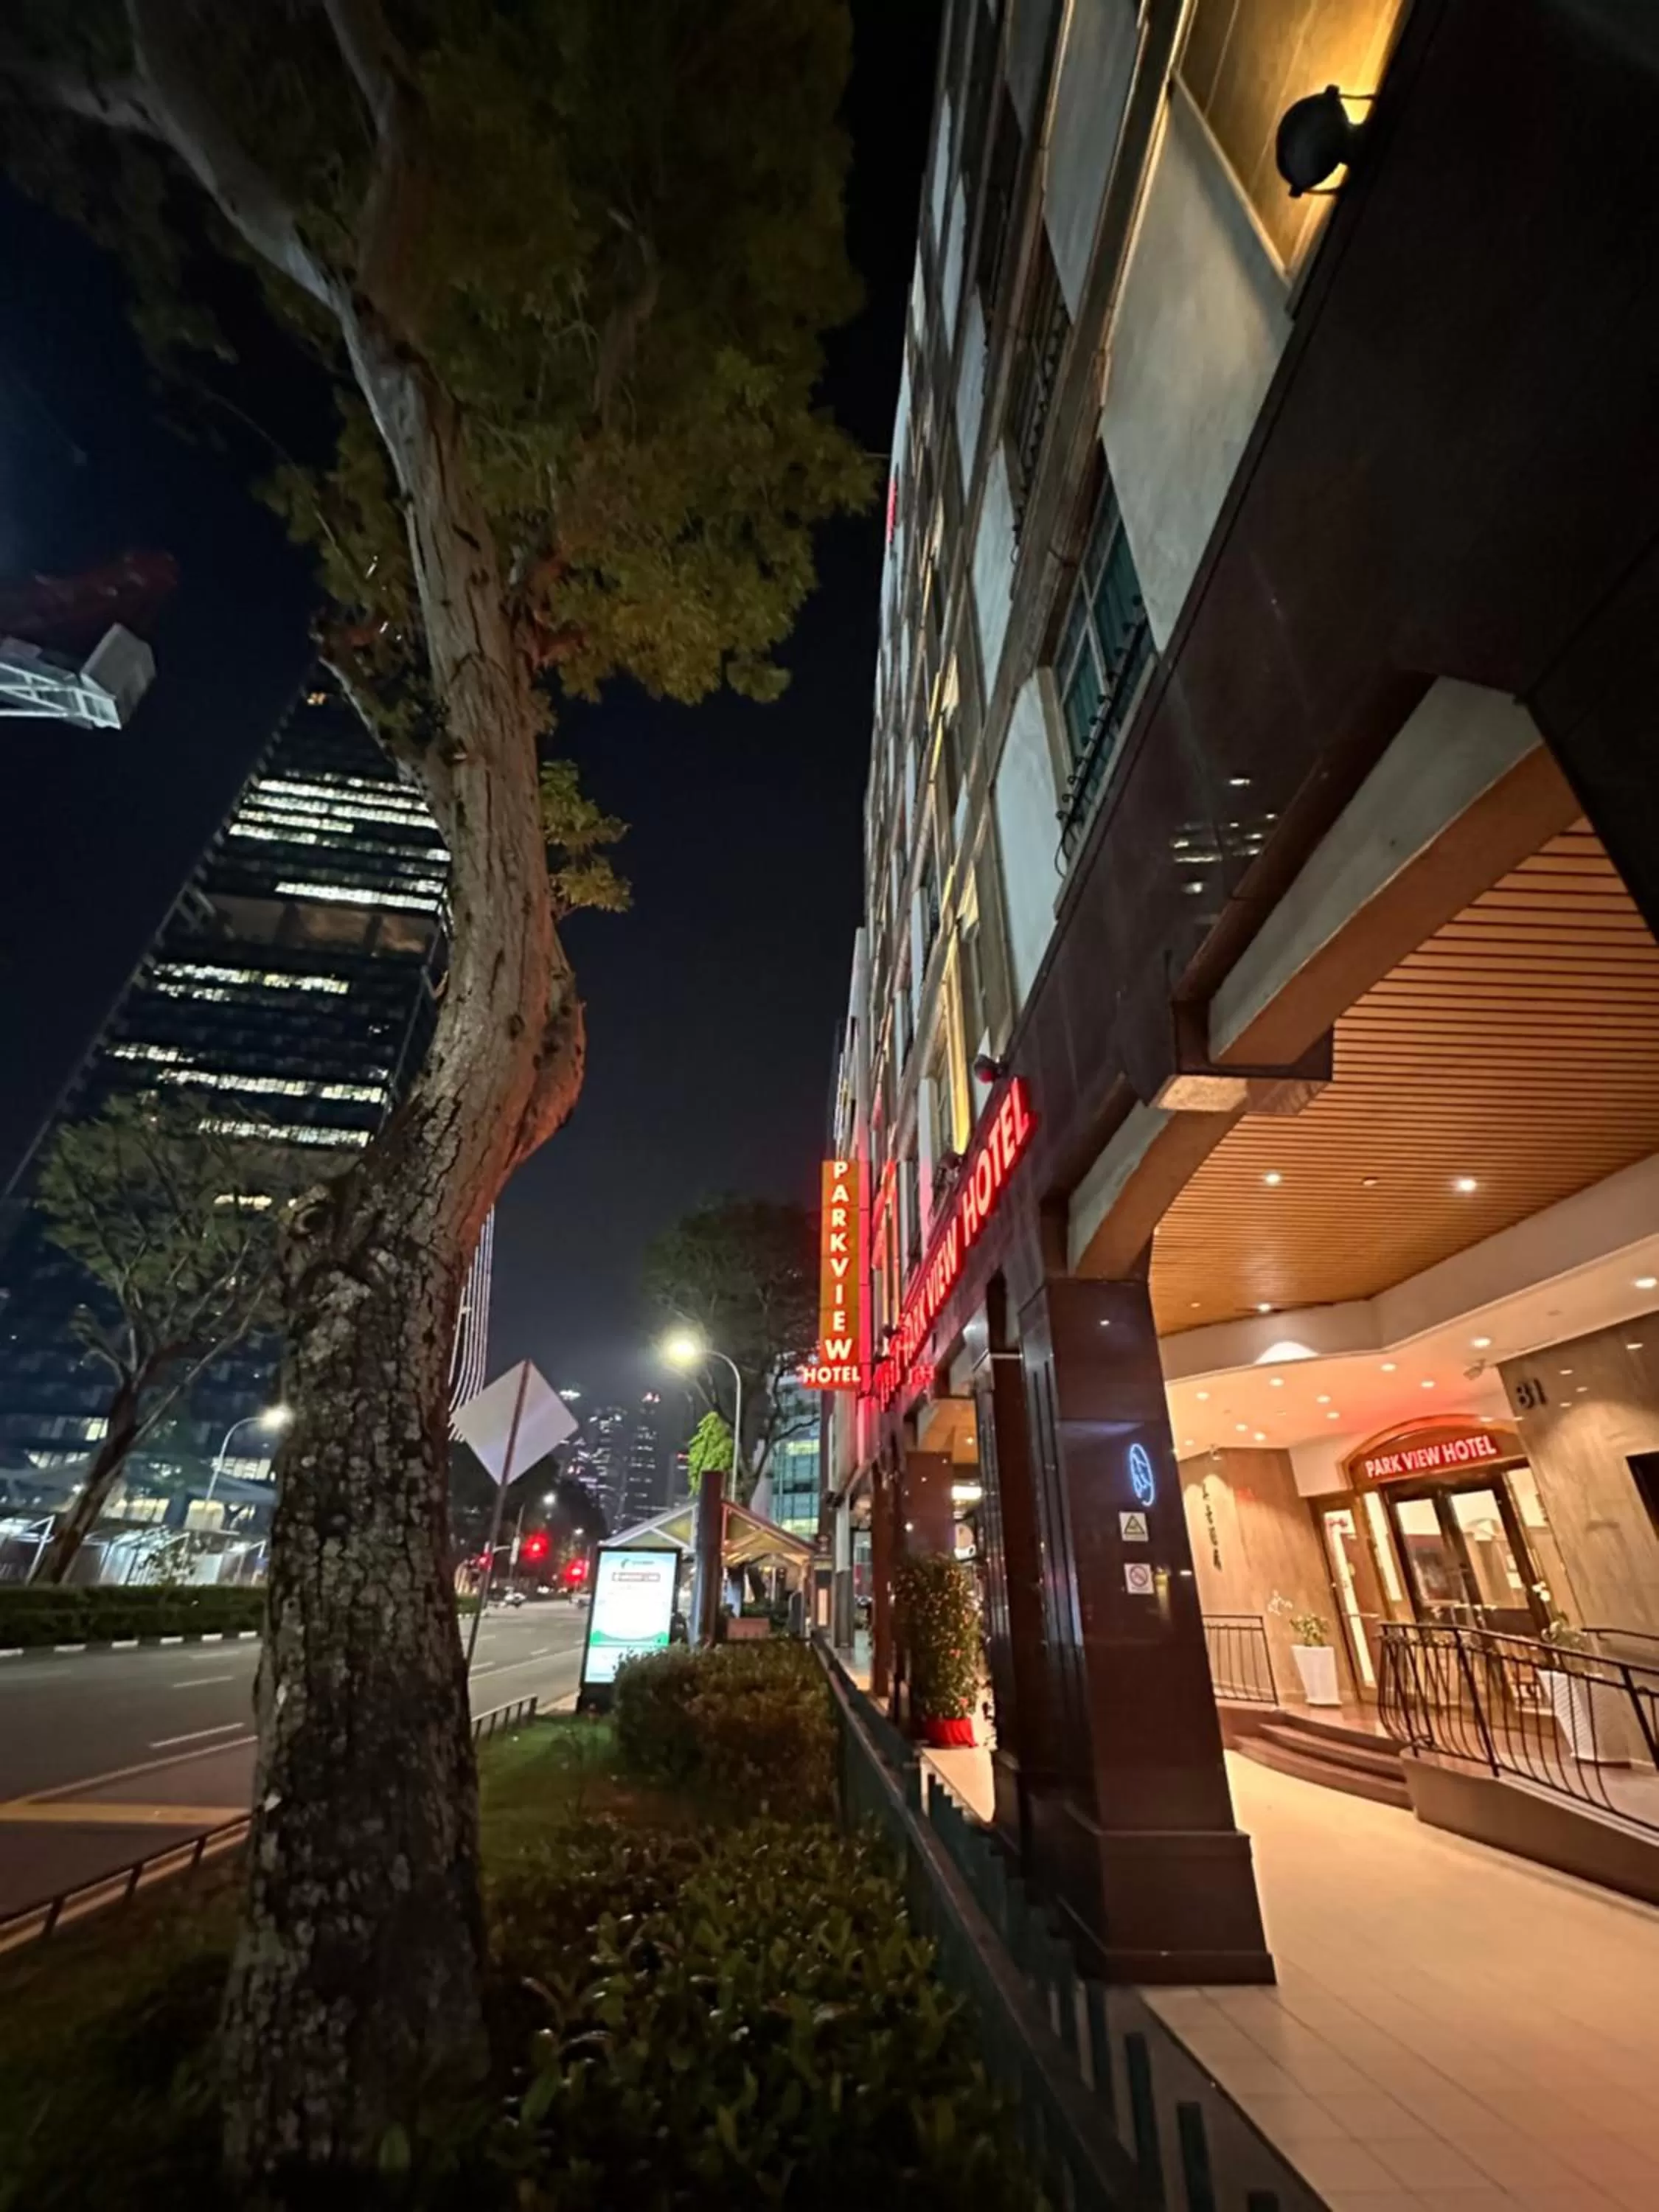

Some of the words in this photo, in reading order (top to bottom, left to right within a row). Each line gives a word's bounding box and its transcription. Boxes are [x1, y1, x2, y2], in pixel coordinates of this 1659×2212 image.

[927, 1216, 957, 1317] VIEW
[962, 1076, 1030, 1247] HOTEL
[803, 1365, 861, 1384] HOTEL
[1365, 1453, 1402, 1478] PARK
[1401, 1445, 1441, 1470] VIEW
[1441, 1434, 1498, 1464] HOTEL
